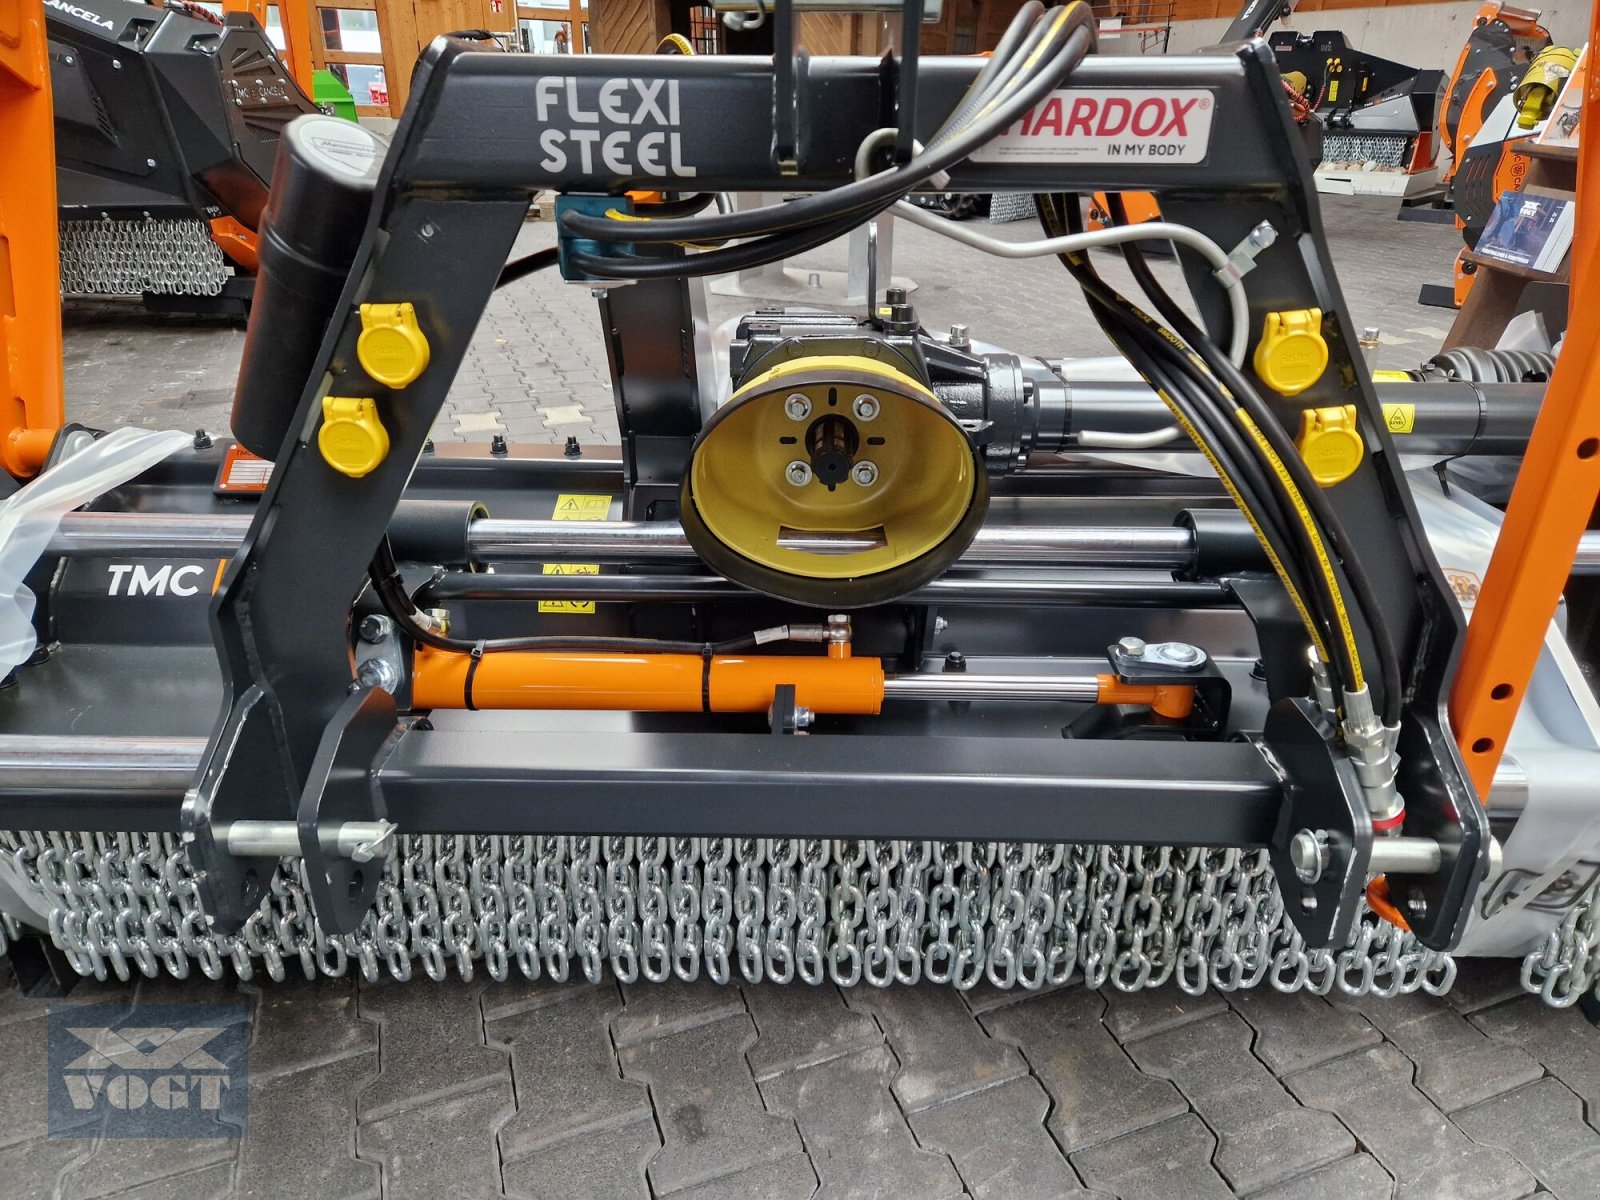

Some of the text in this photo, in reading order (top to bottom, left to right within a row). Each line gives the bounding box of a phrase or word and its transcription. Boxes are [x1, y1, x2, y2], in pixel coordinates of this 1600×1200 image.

[43, 0, 114, 31] ANCELA
[535, 76, 680, 126] FLEXI
[540, 129, 697, 177] STEEL
[1107, 144, 1121, 155] IN
[1124, 144, 1146, 155] MY
[1148, 144, 1187, 156] BODY
[107, 564, 205, 597] TMC
